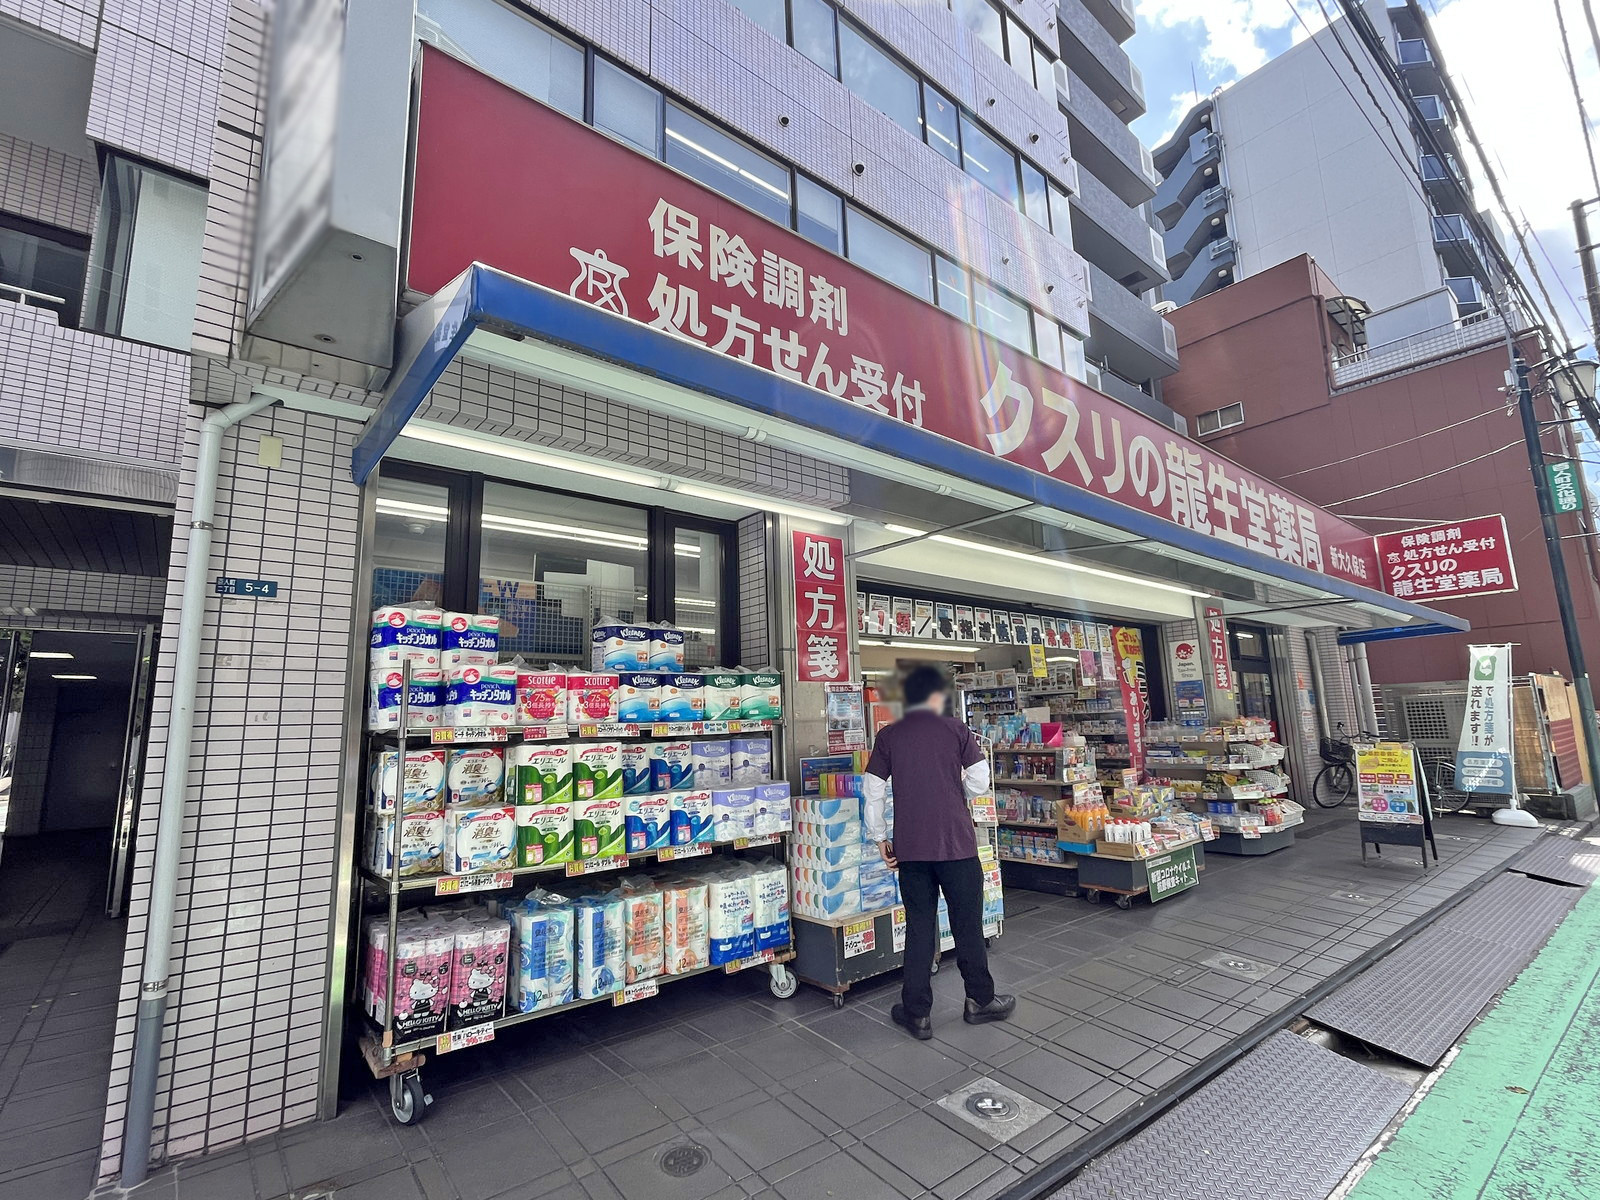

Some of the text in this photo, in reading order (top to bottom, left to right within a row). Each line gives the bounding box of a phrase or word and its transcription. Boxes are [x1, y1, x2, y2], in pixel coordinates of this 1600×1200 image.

[648, 197, 848, 337] 保険調剤
[647, 272, 926, 428] 処方せん受付
[980, 361, 1324, 574] クスリの龍生堂薬局
[1401, 527, 1462, 548] 保険調剤
[1403, 536, 1496, 561] 処方せん受付
[1329, 545, 1367, 579] 新大久保店
[1390, 558, 1458, 581] クスリの
[245, 583, 269, 593] 5-4
[1392, 567, 1504, 597] 龍生堂薬局
[803, 537, 839, 678] 処方箋
[396, 632, 437, 645] キッチンタオル
[620, 628, 646, 639] Kleenex
[664, 631, 682, 642] Kleenex
[458, 637, 496, 648] キッチンタオル
[1209, 610, 1228, 687] 処方箋
[632, 675, 657, 686] Kleenex
[674, 676, 700, 686] Kleenex
[714, 675, 736, 686] Kleenex
[752, 675, 776, 686] Kleenex
[394, 690, 436, 704] キチンタオル
[470, 689, 511, 702] キッチンタオル
[1470, 685, 1483, 746] 送れます!!
[1484, 686, 1495, 746] で処方箋が
[532, 757, 567, 765] エリエール
[637, 805, 666, 814] エリエール
[682, 800, 708, 809] エリエール
[587, 808, 619, 818] エリエール
[532, 815, 567, 825] エリエール
